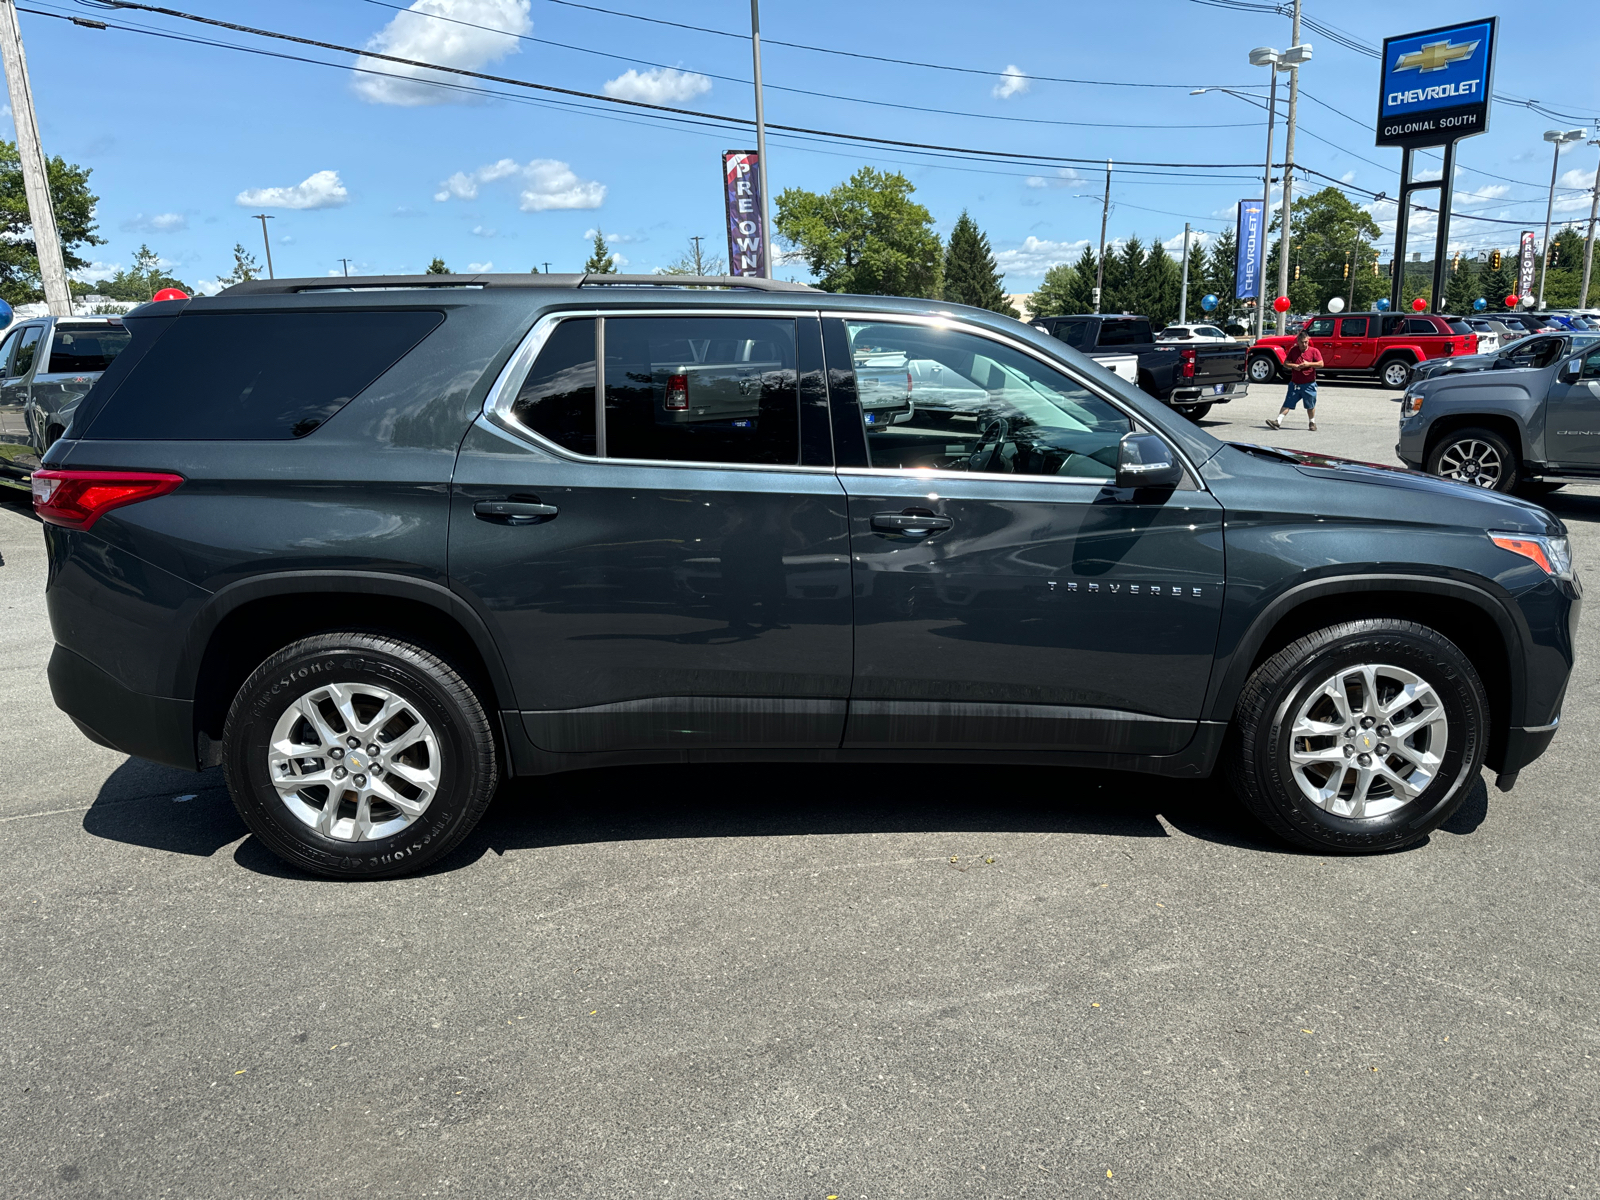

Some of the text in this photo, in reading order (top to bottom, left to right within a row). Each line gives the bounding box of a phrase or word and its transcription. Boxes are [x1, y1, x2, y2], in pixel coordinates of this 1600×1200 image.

[1388, 79, 1480, 106] CHEVROLET
[1384, 114, 1477, 136] COLONIAL SOUTH
[736, 163, 754, 213] PRE
[1245, 215, 1257, 290] CHEVROLET
[1524, 237, 1532, 258] PRE
[1047, 581, 1202, 597] TRAVERSE
